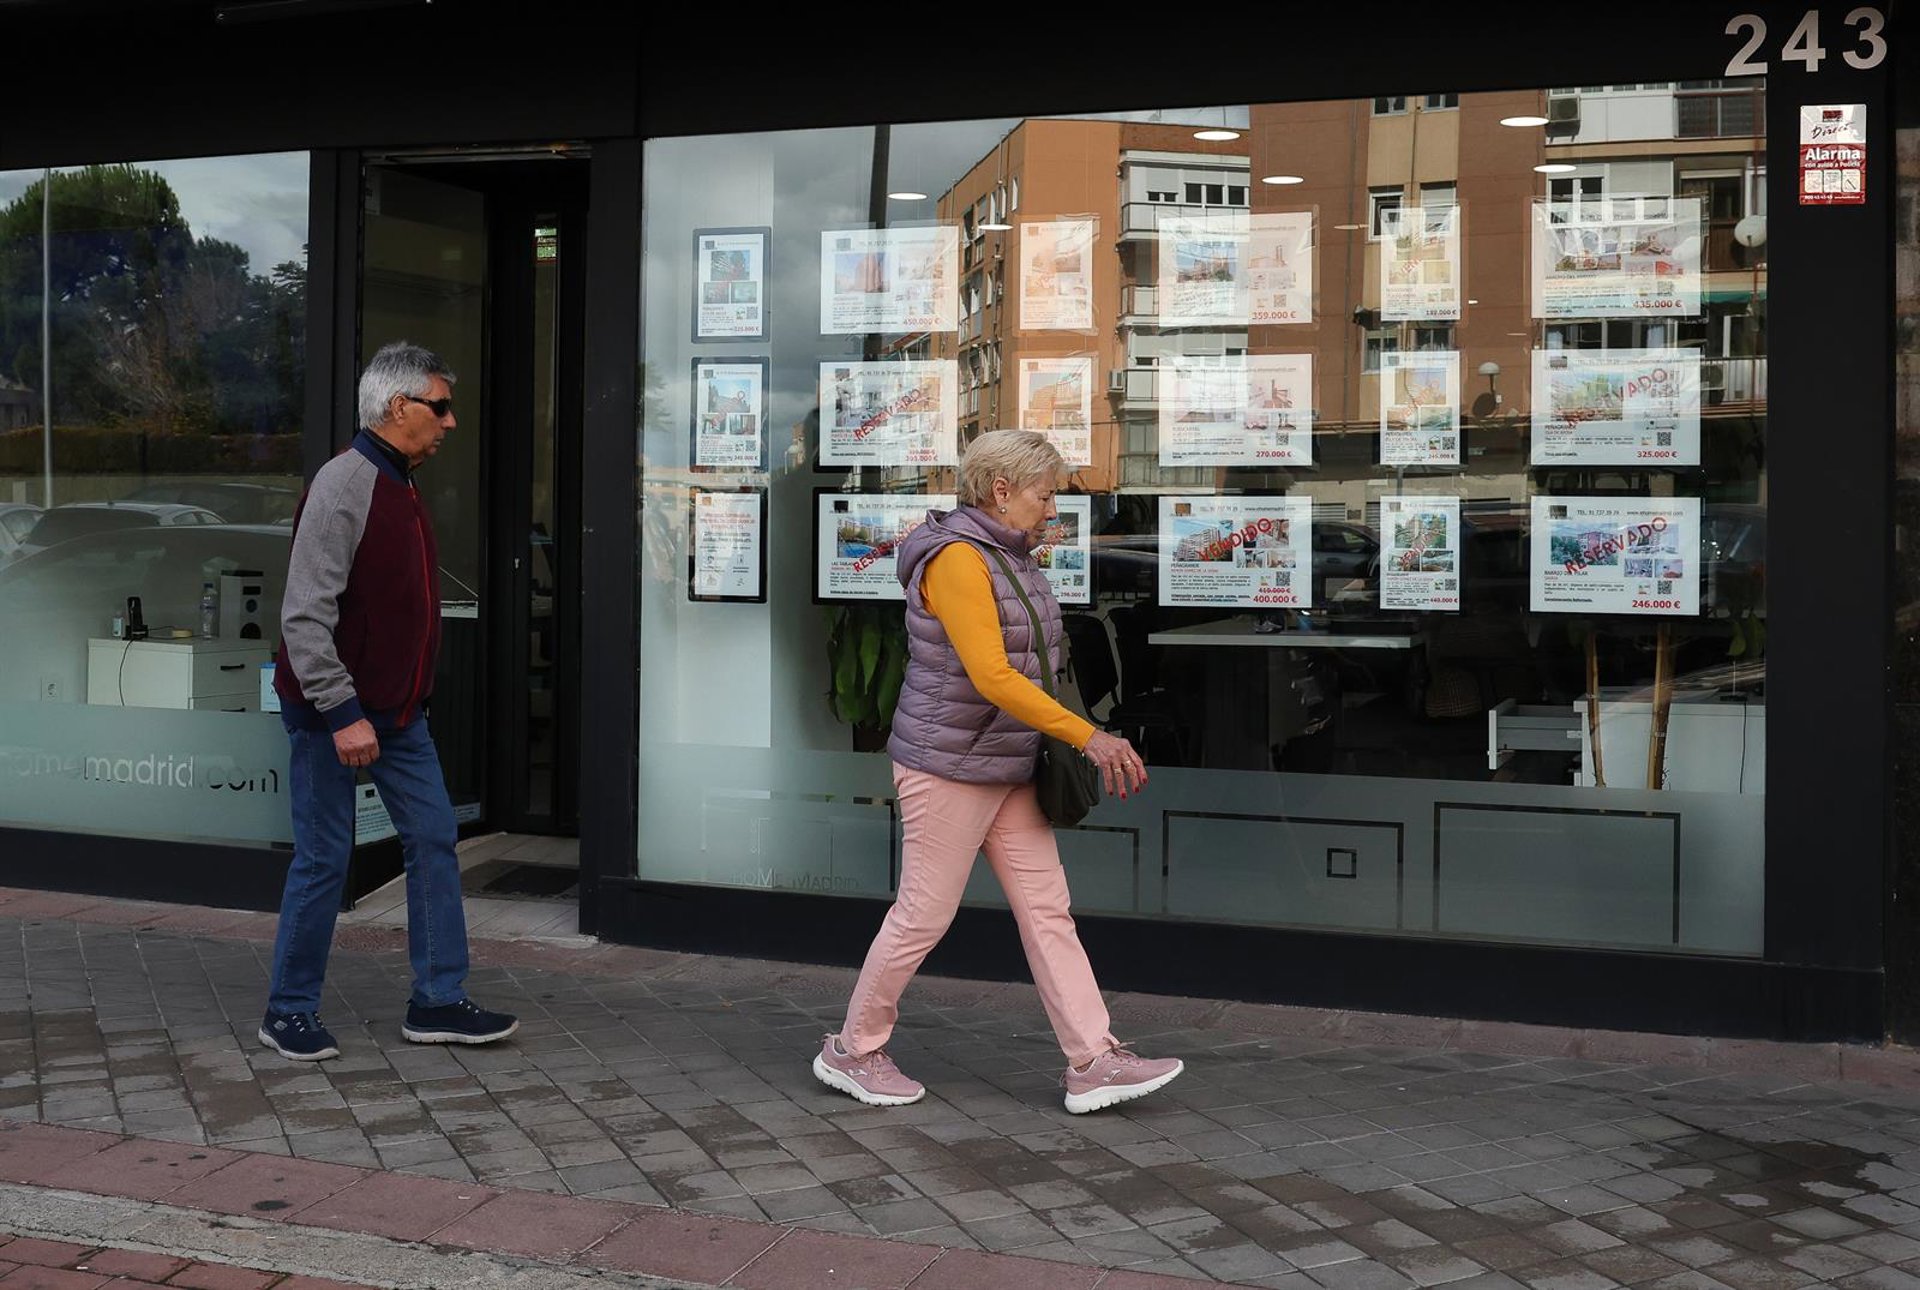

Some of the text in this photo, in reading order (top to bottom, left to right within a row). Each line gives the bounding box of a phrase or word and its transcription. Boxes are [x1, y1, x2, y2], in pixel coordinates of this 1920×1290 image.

[1725, 7, 1888, 77] 243
[1805, 147, 1861, 161] Alarma
[1290, 311, 1297, 319] €
[853, 388, 921, 441] RESERVADO
[1255, 450, 1286, 458] 270.000
[1287, 450, 1292, 458] €
[1637, 450, 1678, 458] 325.000 €
[1195, 517, 1272, 562] VENDIDO
[1564, 516, 1668, 576] RESERVADO
[1253, 595, 1290, 605] 400.000
[1291, 596, 1298, 604] €
[1631, 599, 1681, 609] 246.000 €
